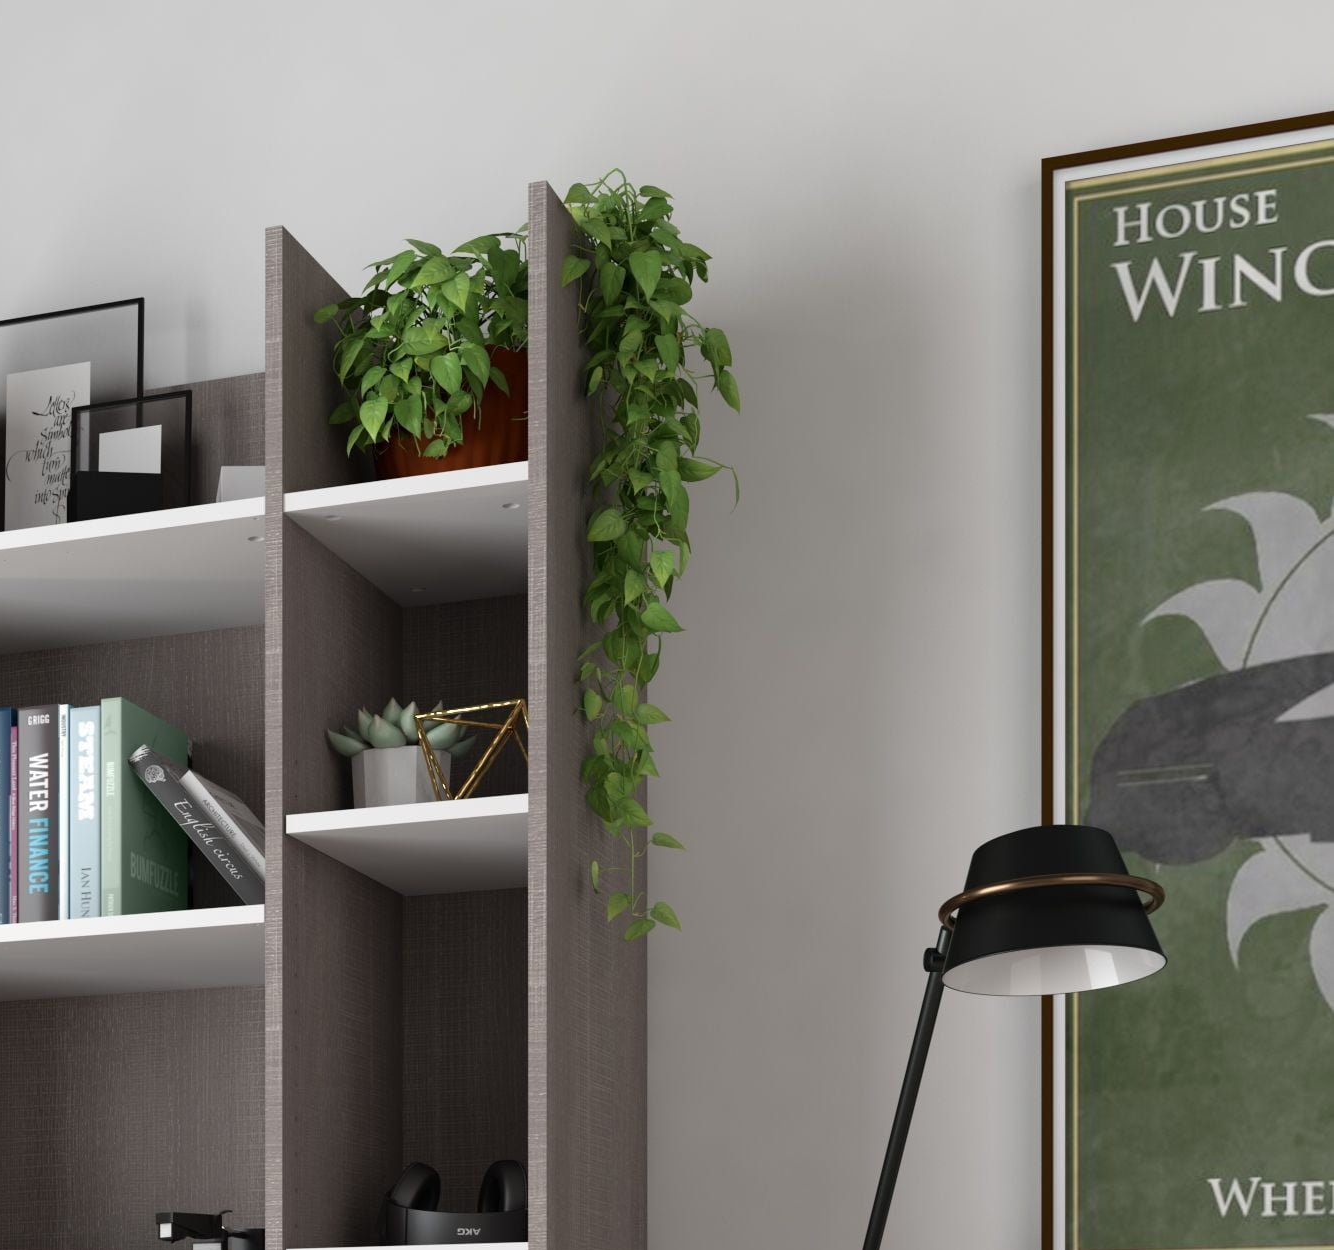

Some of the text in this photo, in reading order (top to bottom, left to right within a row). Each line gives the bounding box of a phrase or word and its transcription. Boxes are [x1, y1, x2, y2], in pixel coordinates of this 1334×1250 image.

[1112, 189, 1279, 247] HOUSE
[27, 713, 50, 726] GRIGG
[77, 720, 95, 821] STEAM
[28, 752, 49, 895] WATER FINANCE
[174, 798, 227, 847] English
[213, 848, 244, 880] circus
[80, 867, 92, 889] IAN
[1207, 1177, 1334, 1218] WHE
[456, 1228, 481, 1236] AKG
